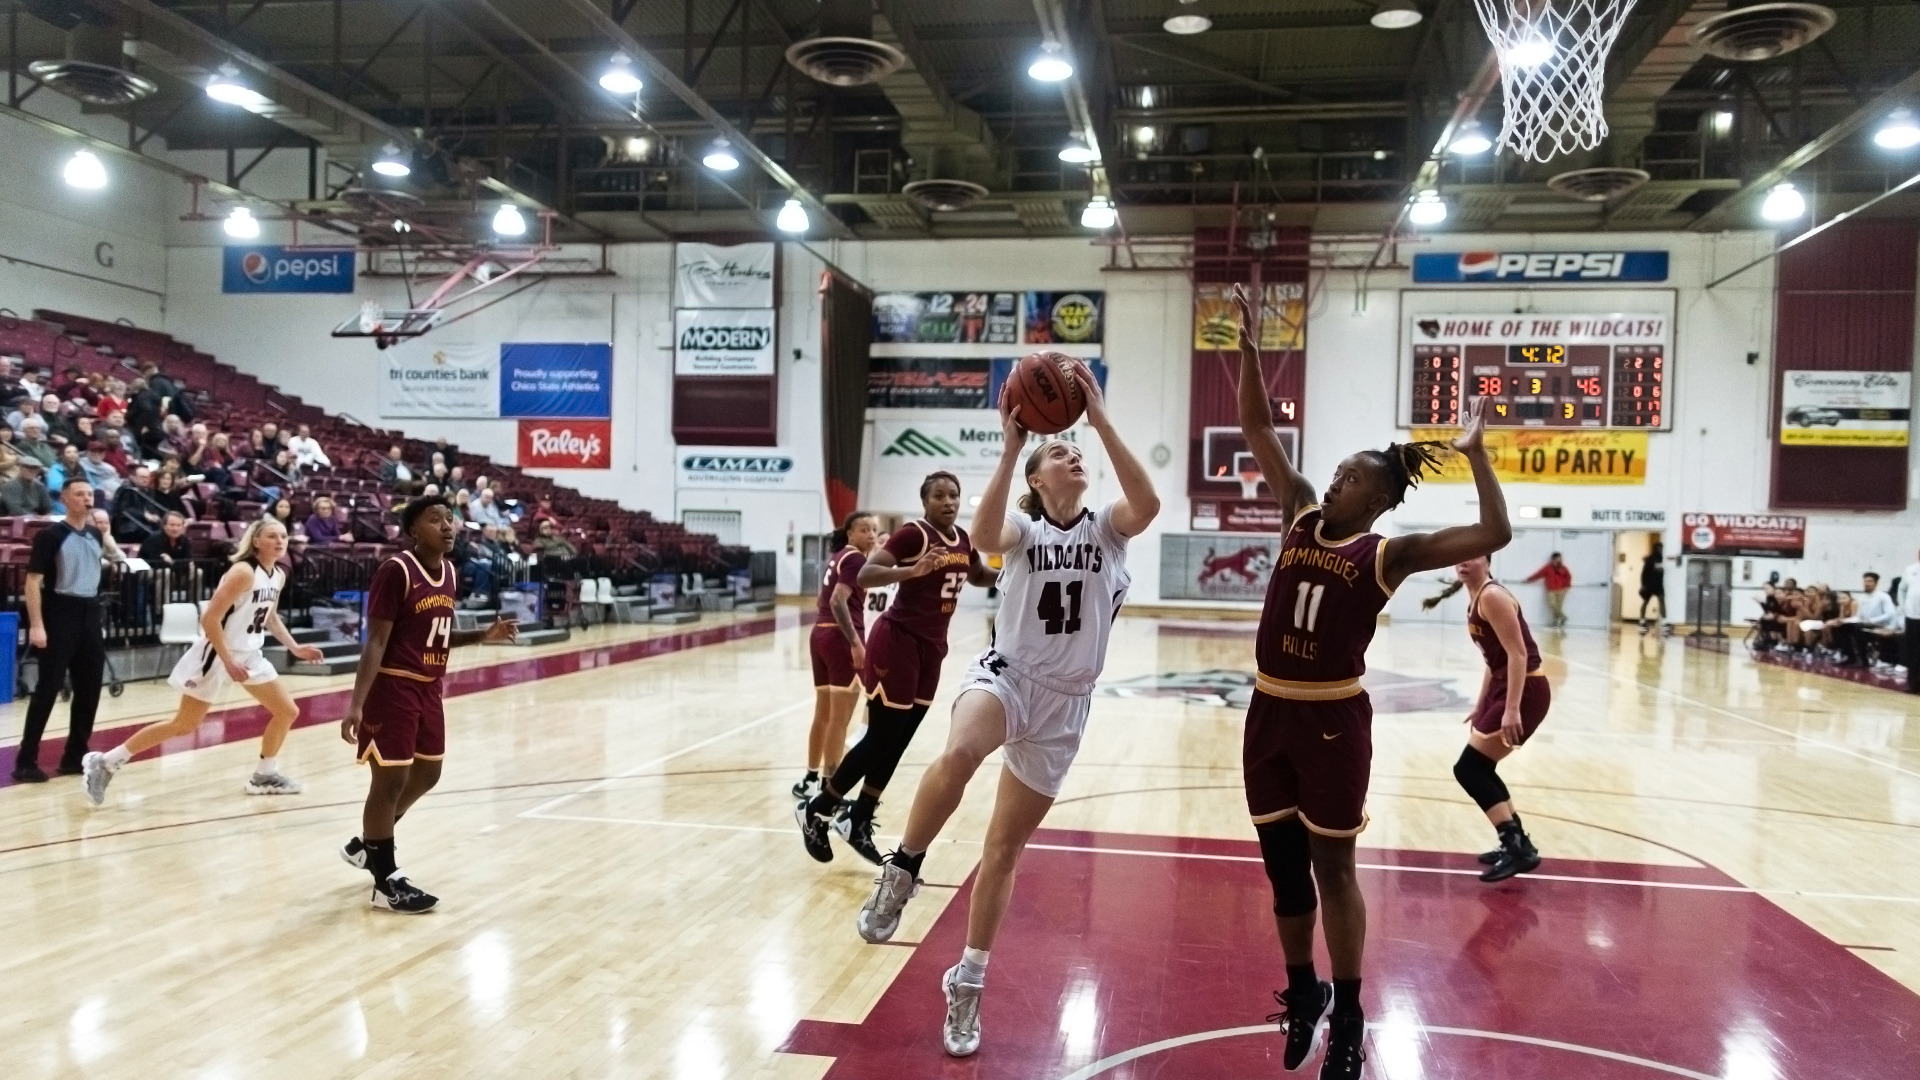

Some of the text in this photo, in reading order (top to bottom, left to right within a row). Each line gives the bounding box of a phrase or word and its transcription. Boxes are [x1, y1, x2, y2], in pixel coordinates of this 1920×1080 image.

[95, 241, 113, 268] G
[275, 255, 339, 280] pepsi
[1497, 253, 1625, 278] PEPSI
[966, 293, 988, 312] 24
[1444, 320, 1662, 337] HOME OF THE WILDCATS!
[681, 327, 770, 350] MODERN
[1432, 357, 1441, 368] 0
[1452, 357, 1459, 368] 3
[1522, 345, 1564, 364] 4:12
[1634, 357, 1643, 369] 2
[1654, 357, 1663, 369] 2
[390, 367, 489, 380] tri counties bank
[514, 368, 598, 380] Proudly supporting
[895, 371, 988, 387] BLAZE
[1436, 372, 1440, 381] 1
[1451, 371, 1459, 381] 9
[1653, 372, 1662, 382] 4
[511, 381, 600, 391] Chico State Athletics
[1031, 367, 1058, 403] NCAA
[1432, 385, 1440, 396] 2
[1450, 385, 1458, 396] 5
[1479, 377, 1502, 395] 38
[1531, 378, 1541, 394] 3
[1577, 377, 1601, 396] 46
[1633, 386, 1642, 398] 0
[1652, 386, 1661, 397] 6
[1281, 401, 1295, 420] 4
[1431, 399, 1440, 410] 0
[1450, 399, 1457, 410] 0
[1496, 405, 1507, 416] 4
[1564, 403, 1574, 419] 3
[1648, 400, 1660, 411] 17
[1431, 413, 1439, 424] 2
[1449, 413, 1457, 424] 2
[1651, 415, 1660, 426] 8
[960, 428, 1048, 442] Memrs
[530, 428, 601, 463] Raley's
[691, 457, 782, 471] LAMAR
[1518, 450, 1545, 473] TO
[1555, 450, 1635, 474] PARTY
[1592, 509, 1665, 521] BUTTE STRONG
[1685, 513, 1804, 530] GO WILDCATS!
[1027, 543, 1103, 574] WILDCATS
[1280, 547, 1359, 588] DOMINGUEZ
[868, 593, 888, 612] 20
[1037, 581, 1083, 634] 41
[1294, 581, 1325, 633] 11
[426, 617, 452, 649] 14
[1283, 634, 1318, 660] HILLS
[423, 653, 448, 666] HILLS
